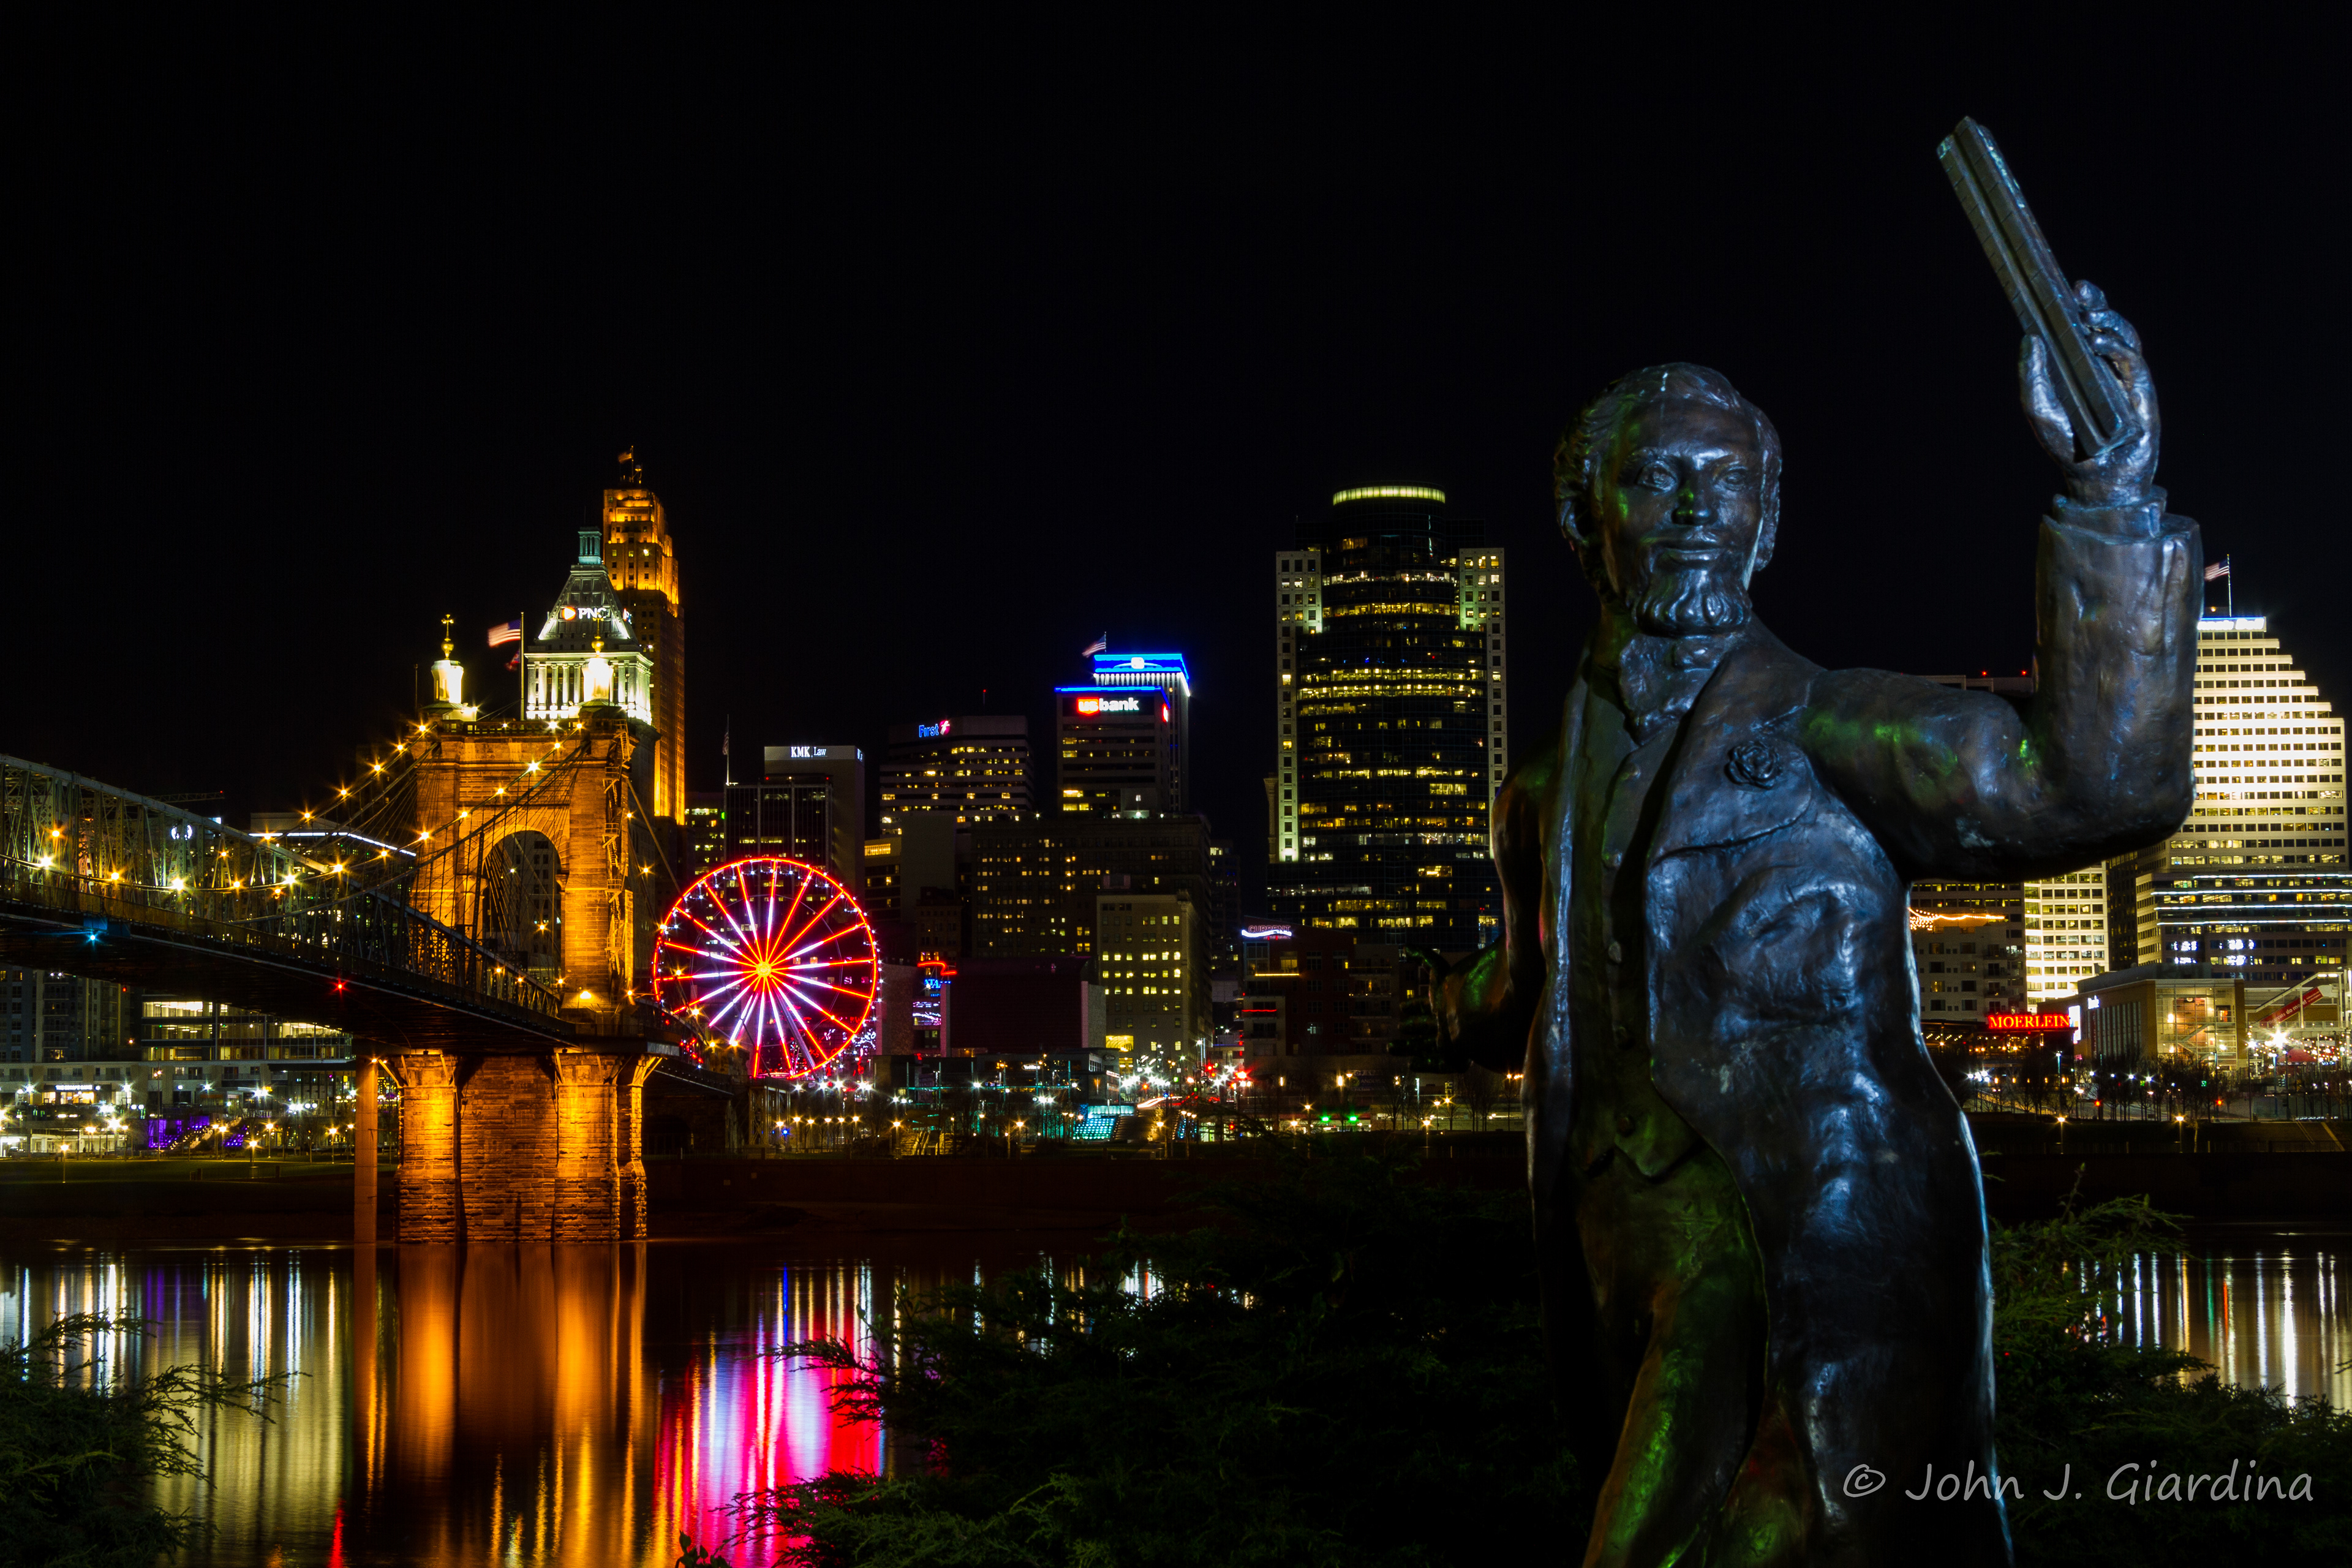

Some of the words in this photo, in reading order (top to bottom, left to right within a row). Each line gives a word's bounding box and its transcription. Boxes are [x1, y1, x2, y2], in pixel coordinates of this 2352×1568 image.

[578, 608, 606, 619] PNC
[919, 723, 939, 737] First
[791, 747, 810, 757] KMK
[813, 747, 826, 756] Law
[1989, 1016, 2070, 1028] MOERLEIN
